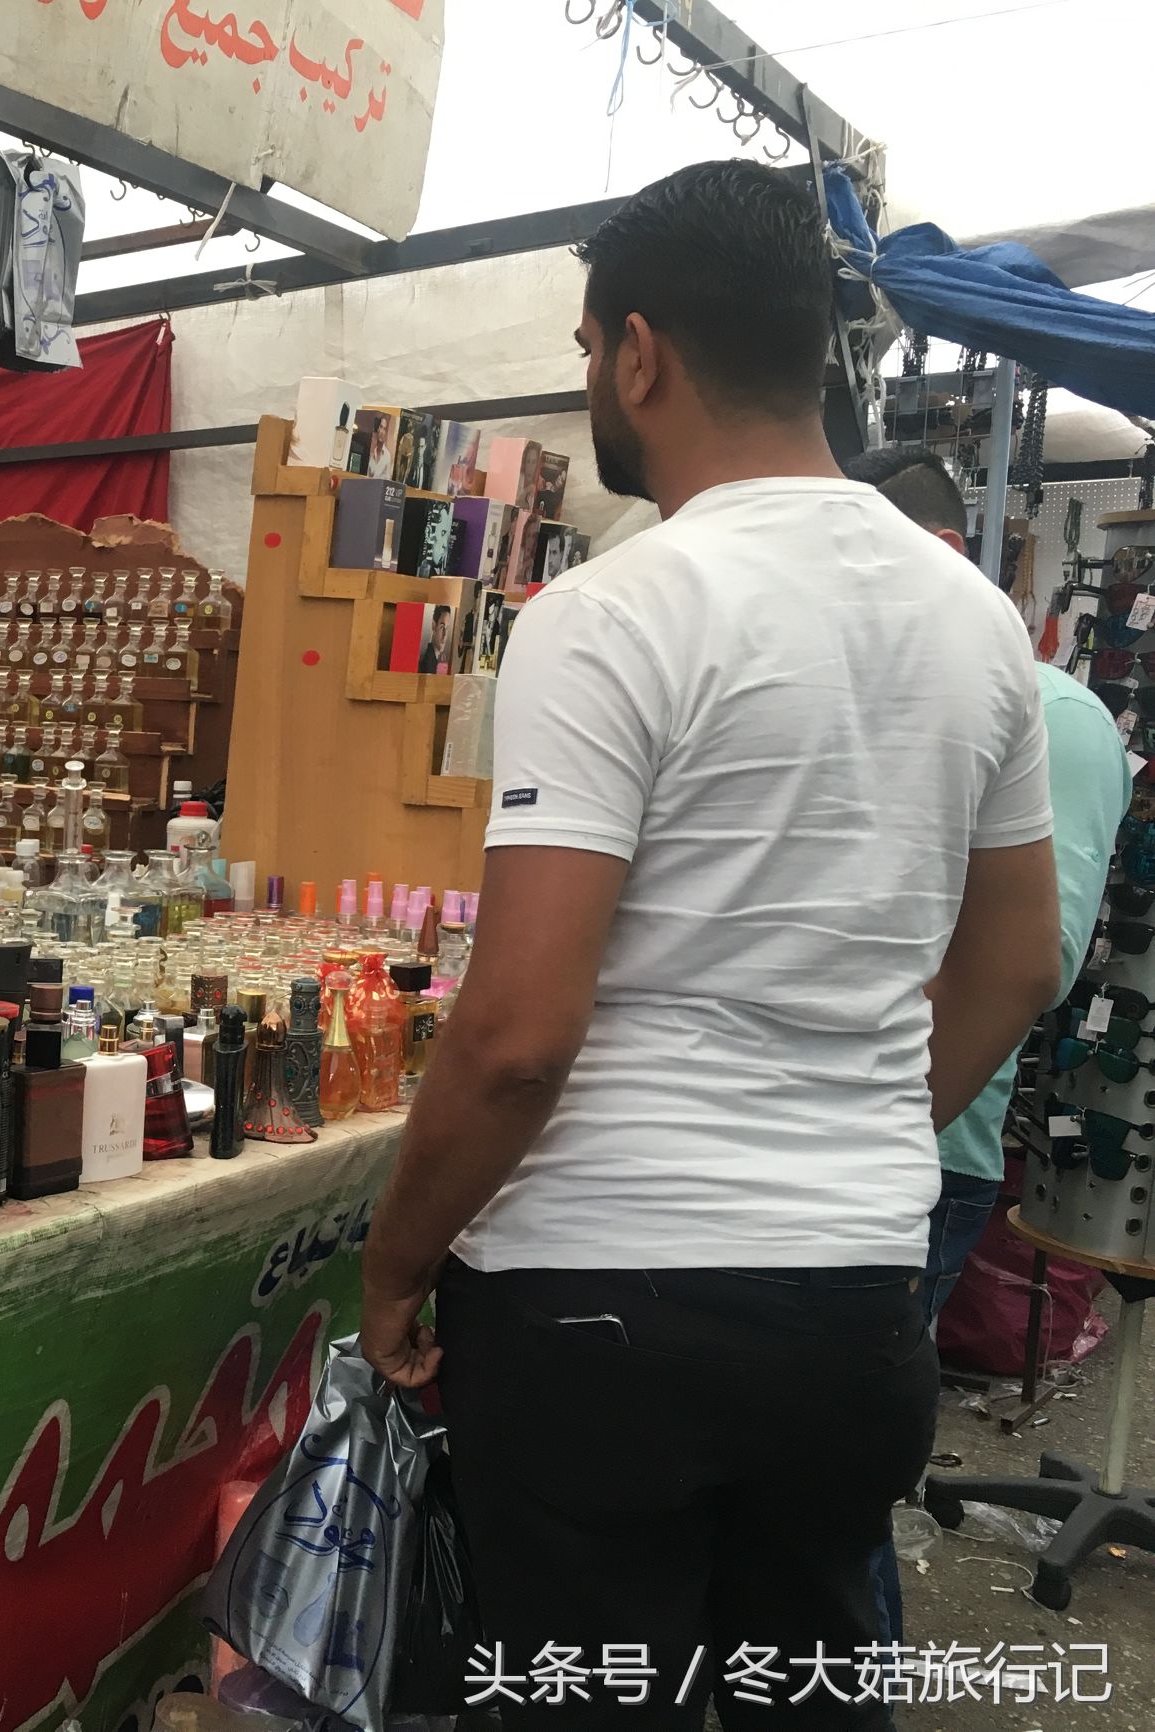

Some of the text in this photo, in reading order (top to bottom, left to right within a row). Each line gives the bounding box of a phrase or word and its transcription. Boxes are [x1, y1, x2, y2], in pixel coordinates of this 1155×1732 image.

[160, 0, 392, 132] تركيب جميع
[92, 1139, 138, 1154] TRUSSARDI
